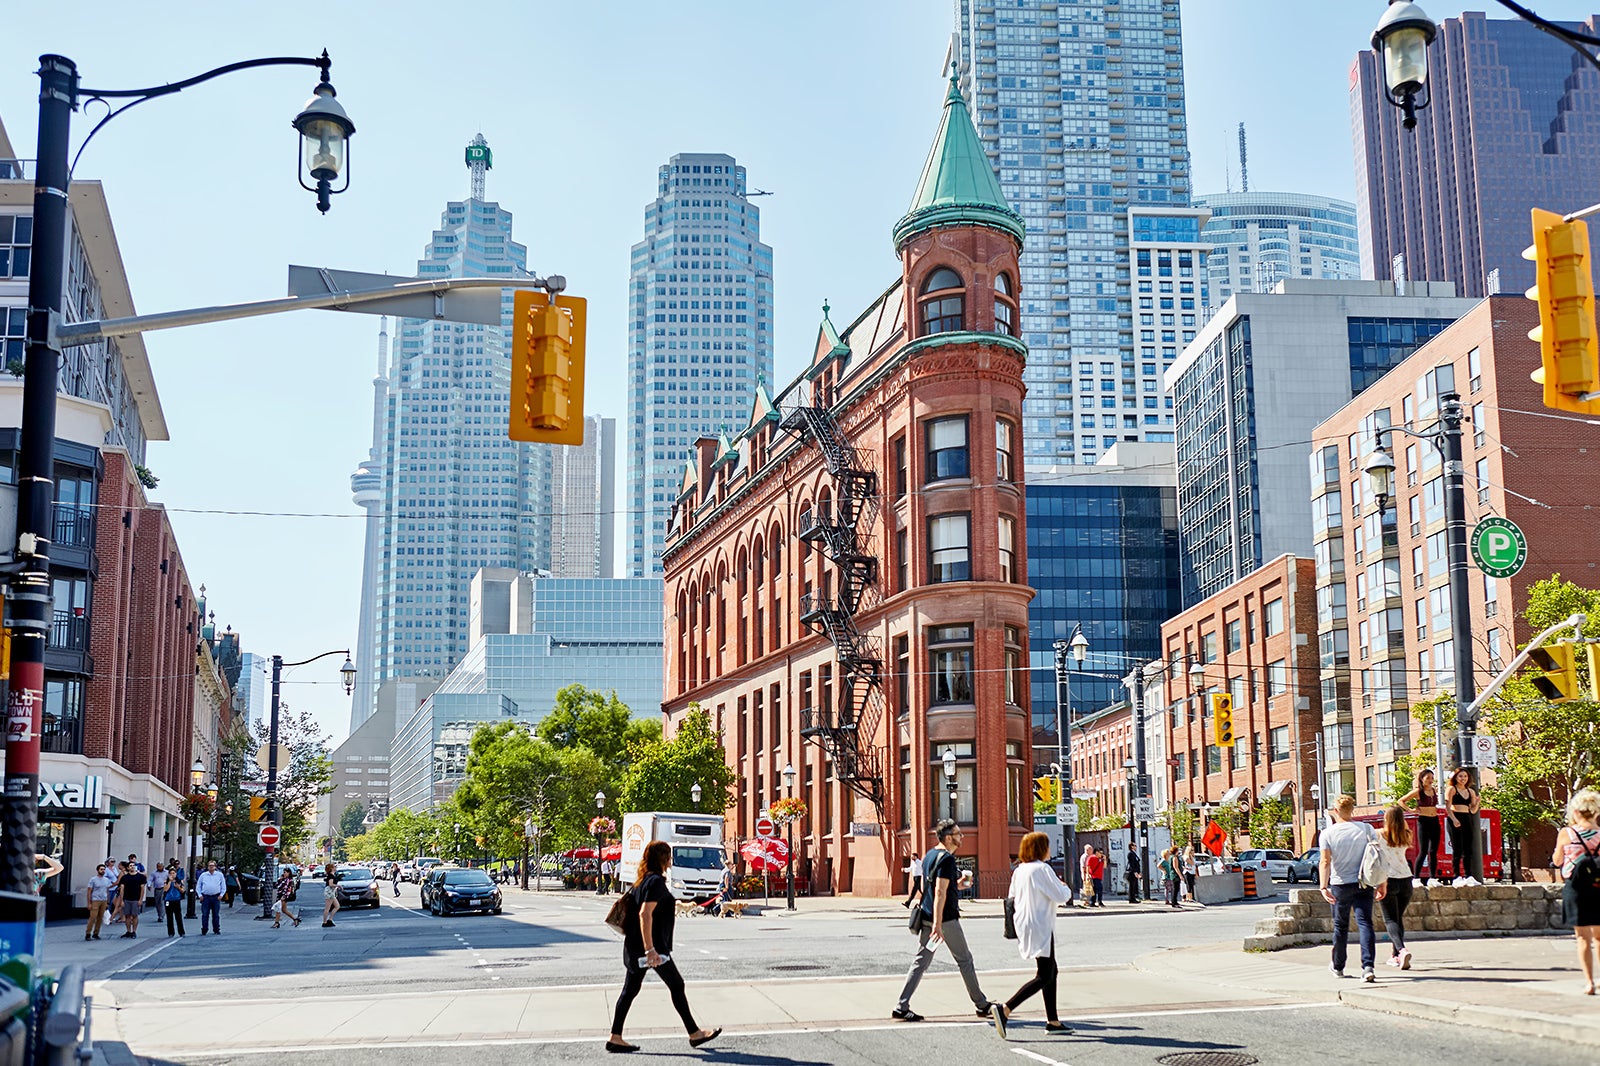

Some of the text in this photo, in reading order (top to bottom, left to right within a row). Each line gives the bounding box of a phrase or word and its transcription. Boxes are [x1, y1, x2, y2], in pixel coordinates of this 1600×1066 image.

[470, 148, 483, 157] TD
[1472, 520, 1524, 546] MUNICIPAL
[1488, 533, 1510, 556] P
[1473, 552, 1524, 576] PARKING
[8, 690, 33, 706] OLD
[38, 775, 103, 808] xall
